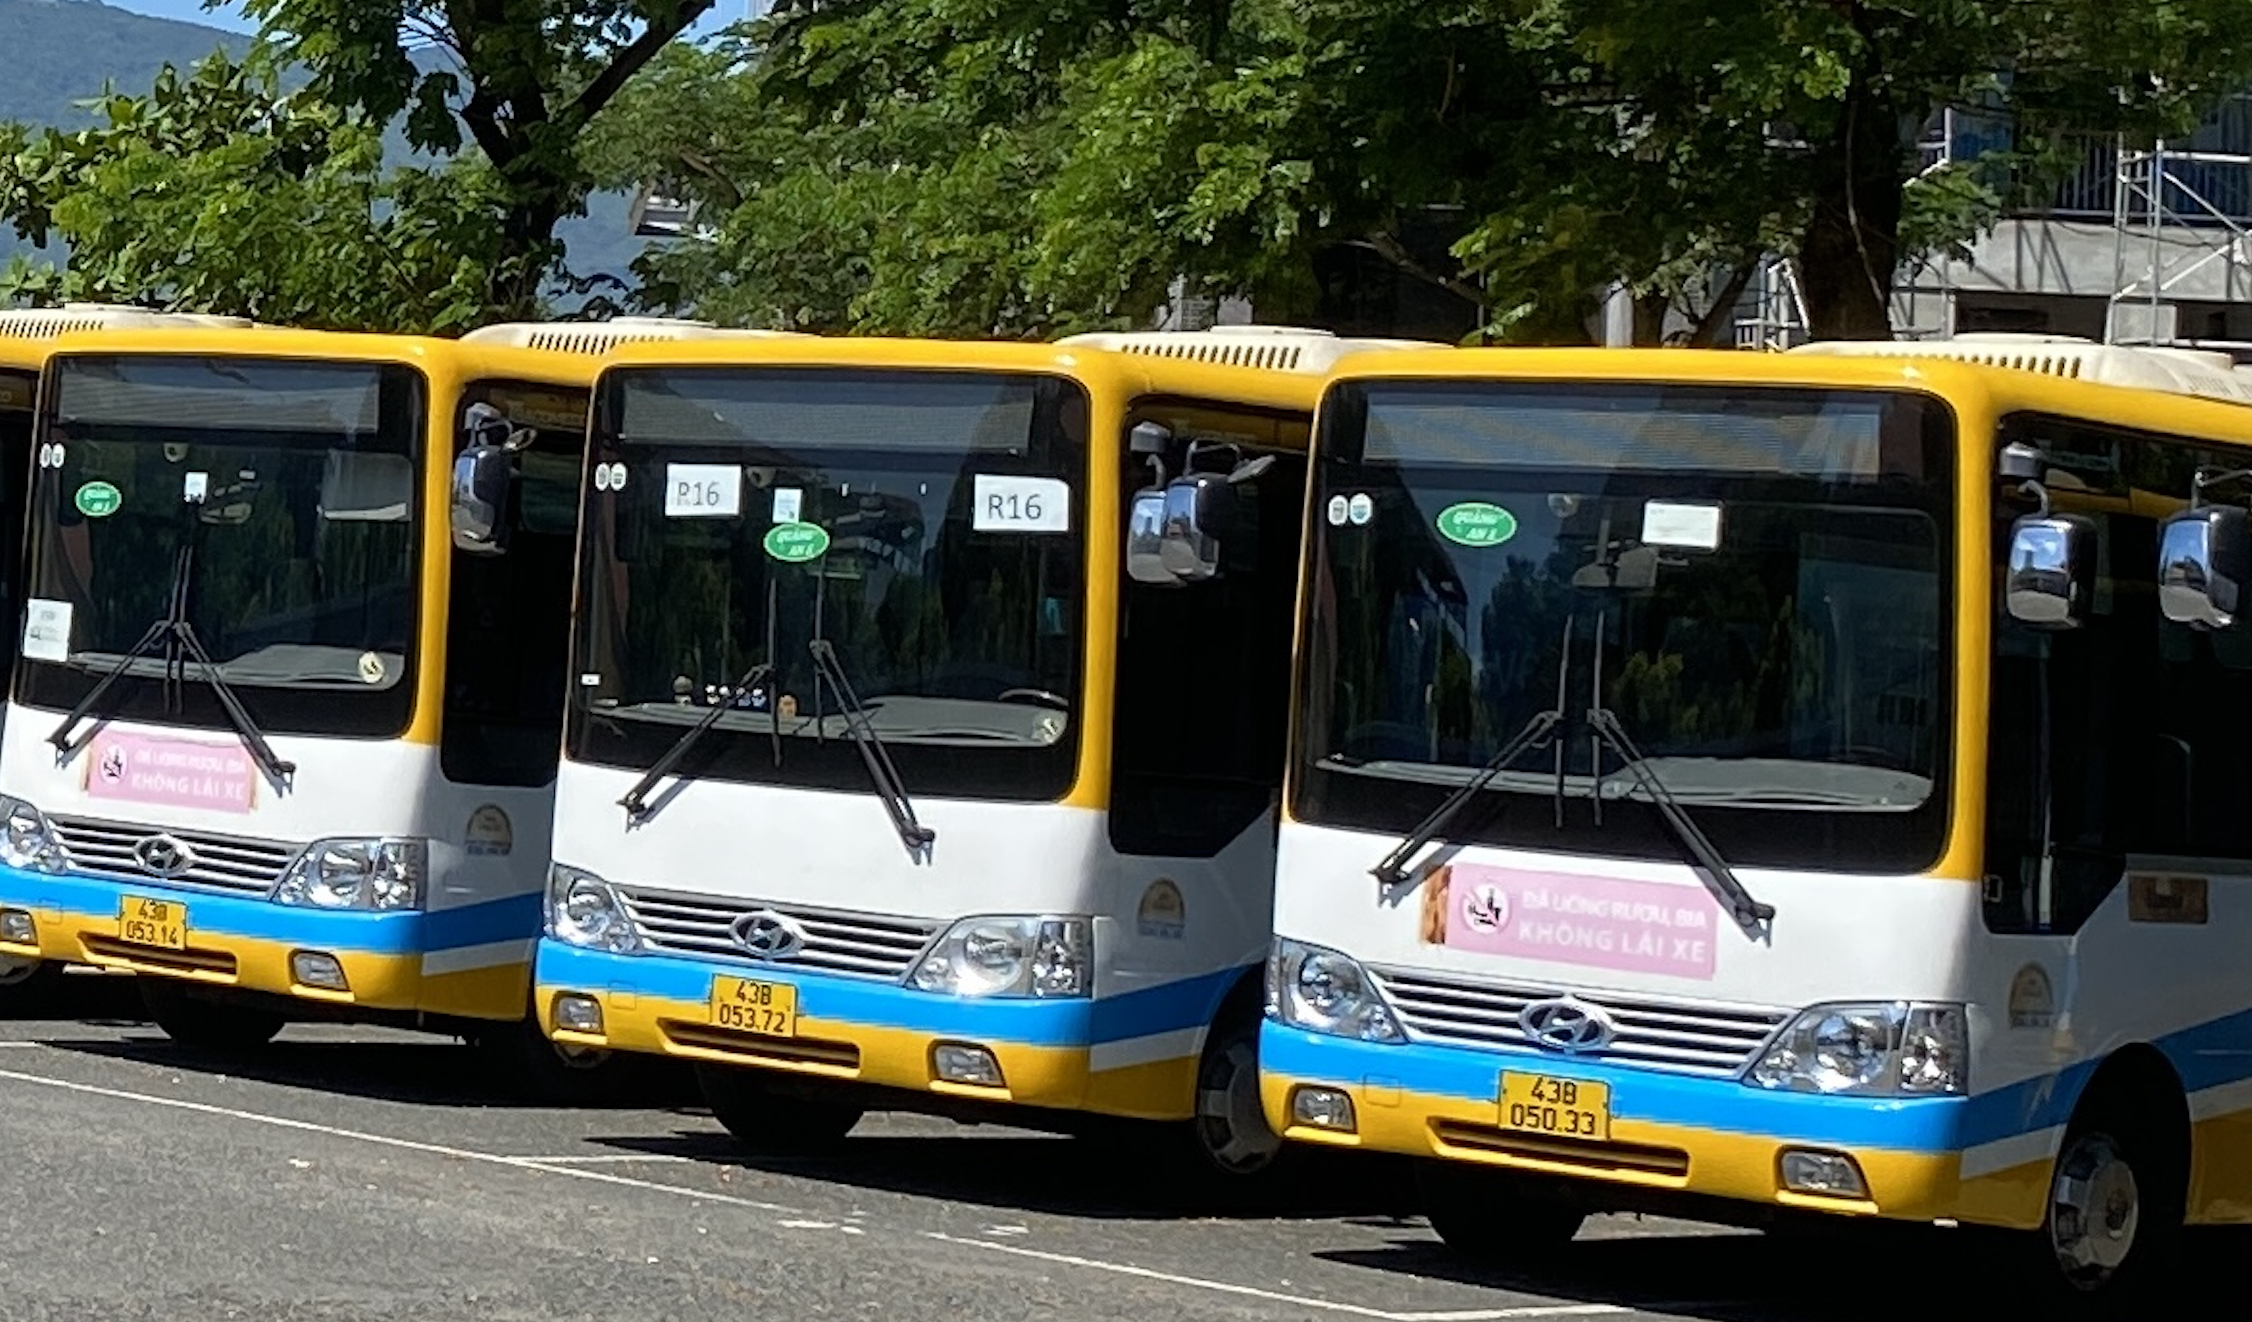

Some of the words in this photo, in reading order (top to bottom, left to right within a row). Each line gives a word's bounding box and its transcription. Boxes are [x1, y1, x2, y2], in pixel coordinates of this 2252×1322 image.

[677, 481, 720, 507] R16
[988, 493, 1042, 520] R16
[131, 770, 189, 794] KHÔNG
[1519, 919, 1613, 952] KHÔNG
[1621, 928, 1664, 957] LÁI
[1672, 938, 1706, 963] XE
[736, 980, 772, 1006] 43B
[719, 1003, 786, 1033] 053.72
[1531, 1076, 1578, 1105] 43B
[1511, 1103, 1596, 1135] 050.33
